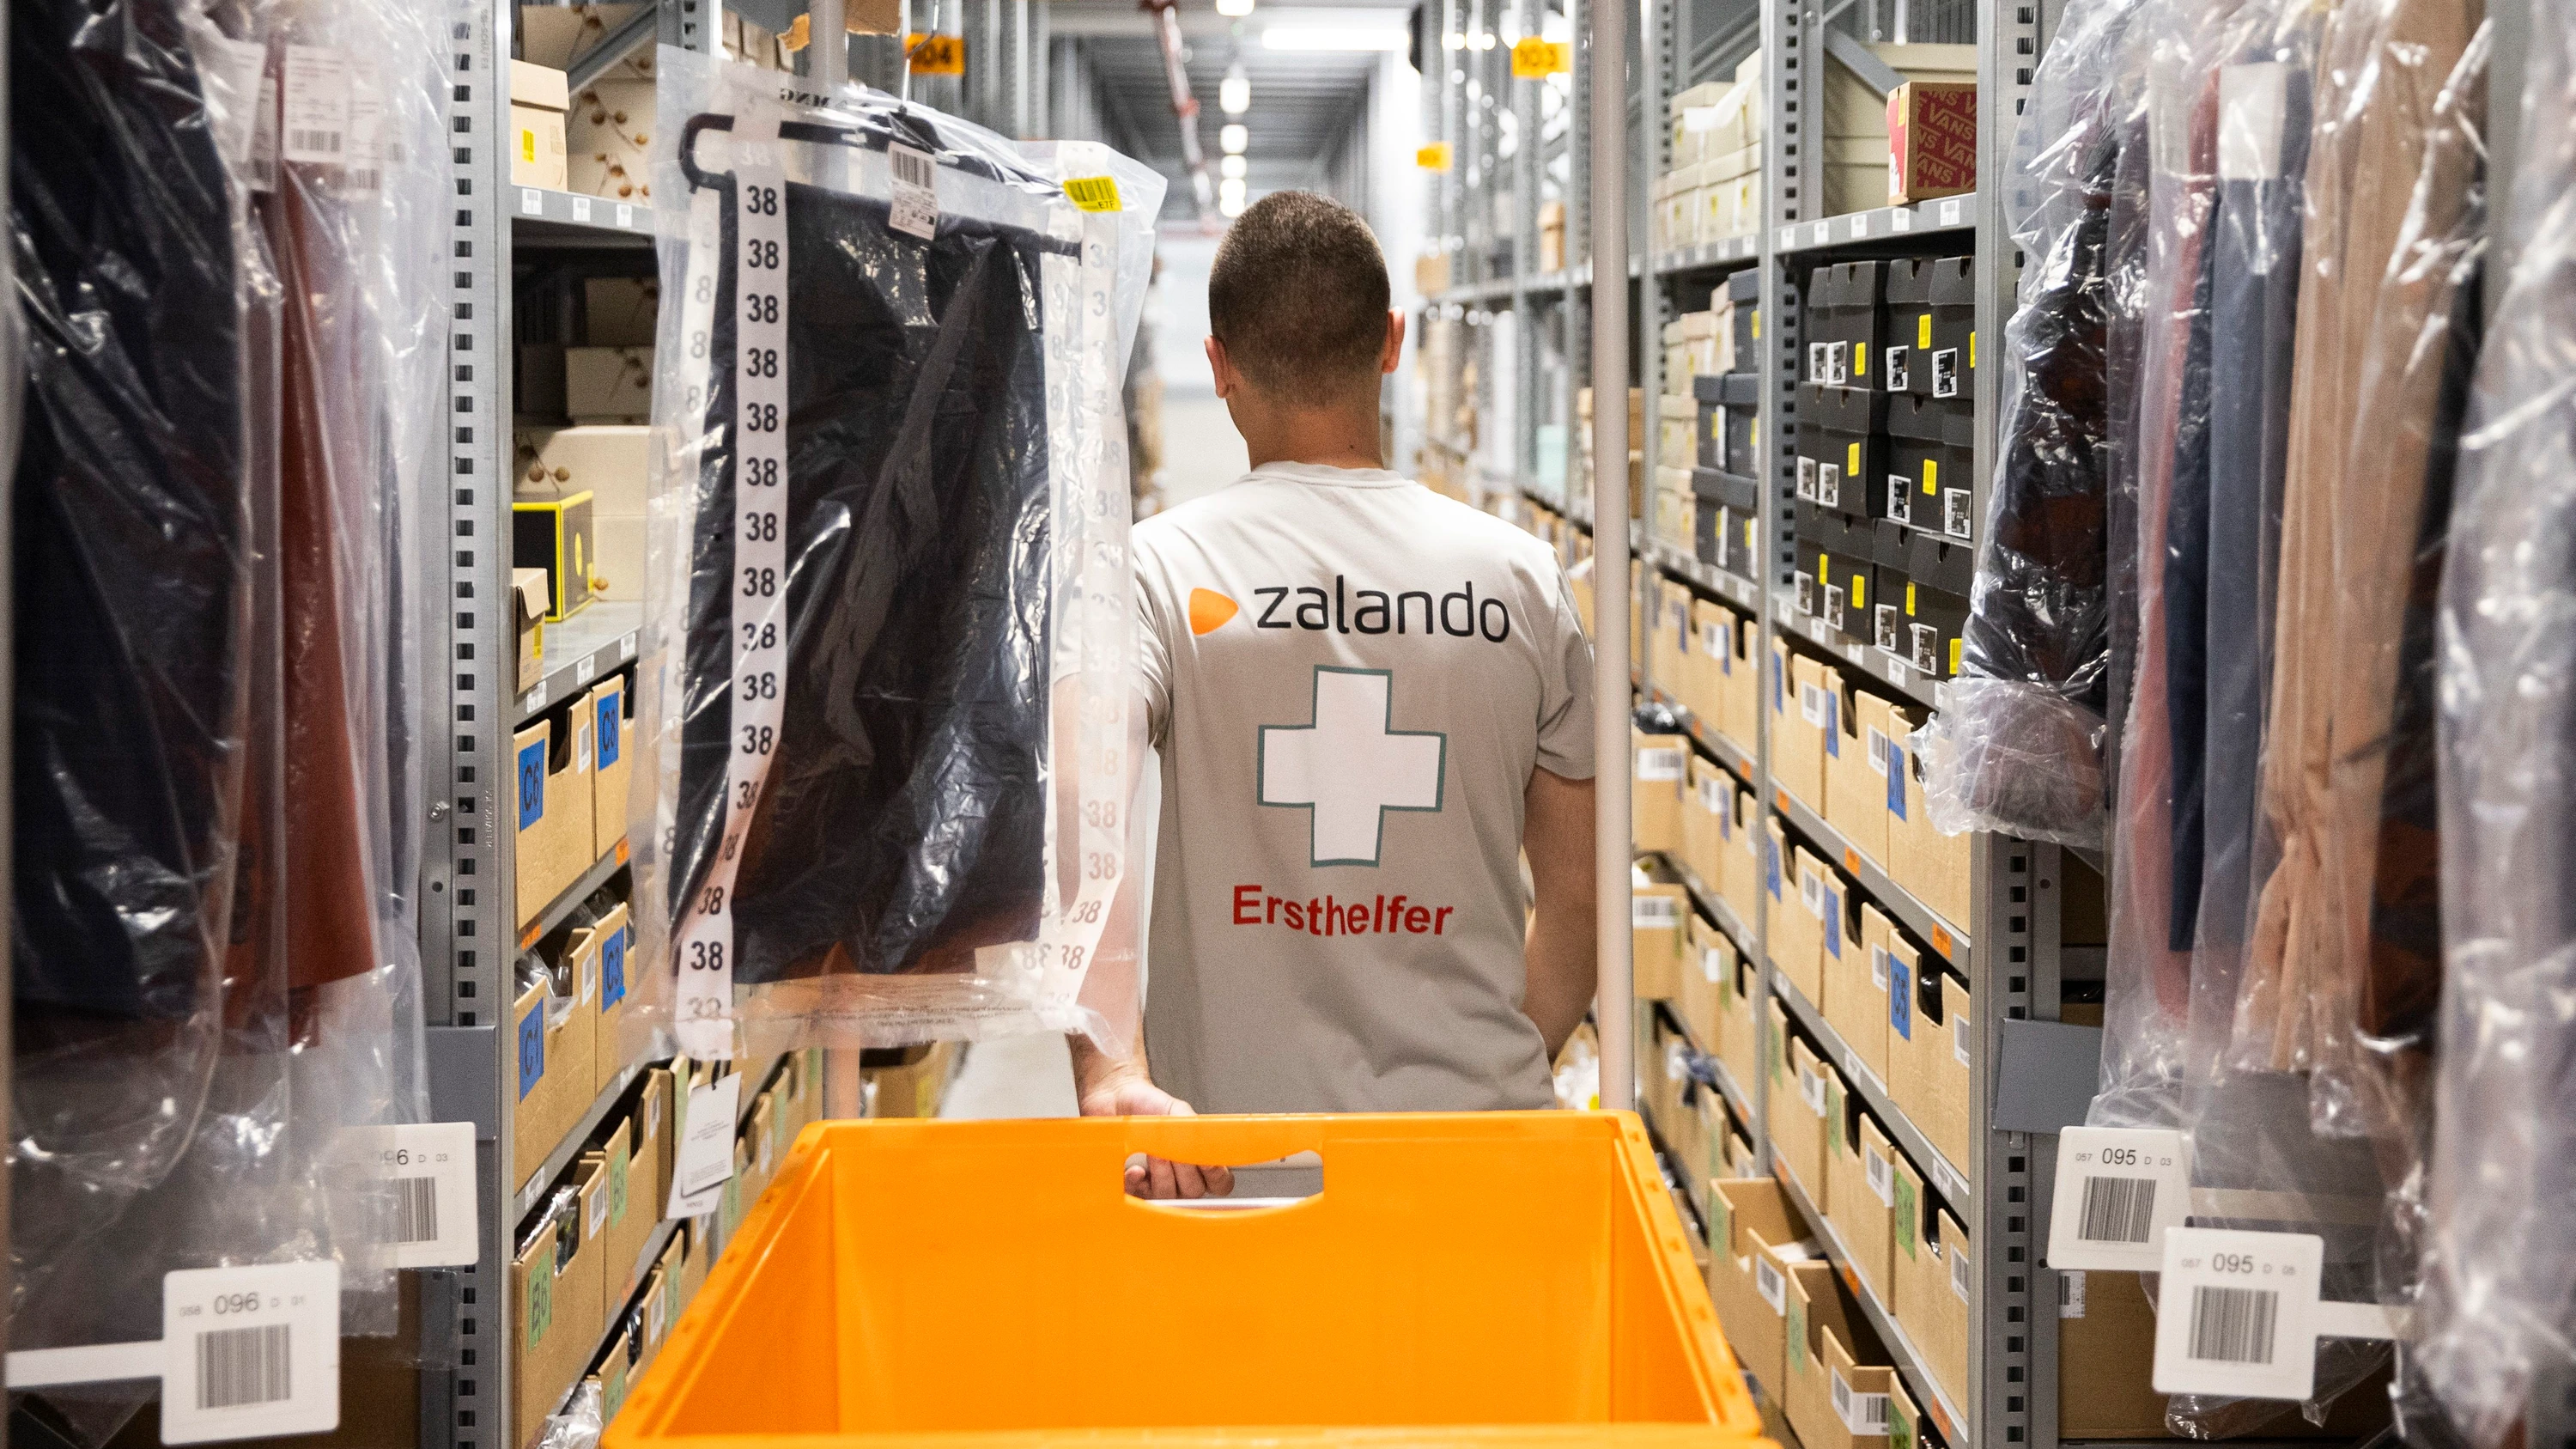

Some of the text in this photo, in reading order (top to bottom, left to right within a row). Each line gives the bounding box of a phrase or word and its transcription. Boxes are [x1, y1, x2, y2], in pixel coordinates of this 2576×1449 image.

[1929, 102, 1974, 140] VANS
[1944, 136, 1976, 169] VAN
[1917, 155, 1953, 184] ANS
[746, 186, 777, 216] 38
[747, 239, 779, 270] 38
[746, 293, 779, 323] 38
[746, 347, 778, 378] 38
[746, 402, 778, 432] 38
[745, 457, 778, 486] 38
[744, 512, 777, 541] 38
[742, 567, 776, 597] 38
[1254, 575, 1510, 642] zalando
[742, 622, 776, 651] 38
[742, 672, 777, 701] 38
[741, 724, 773, 755] 38
[524, 761, 539, 812] C6
[736, 781, 759, 810] 38
[1087, 800, 1117, 829] 38
[1088, 852, 1116, 880] 38
[697, 886, 724, 916] 38
[1072, 900, 1103, 924] 38
[1232, 884, 1454, 936] Ersthelfer
[690, 941, 723, 971] 38
[1893, 972, 1907, 1022] C5
[418, 1154, 427, 1163] D
[436, 1153, 447, 1162] 03
[2075, 1148, 2172, 1166] 057 095 D 03
[2213, 1253, 2253, 1273] 095
[215, 1292, 258, 1314] 096
